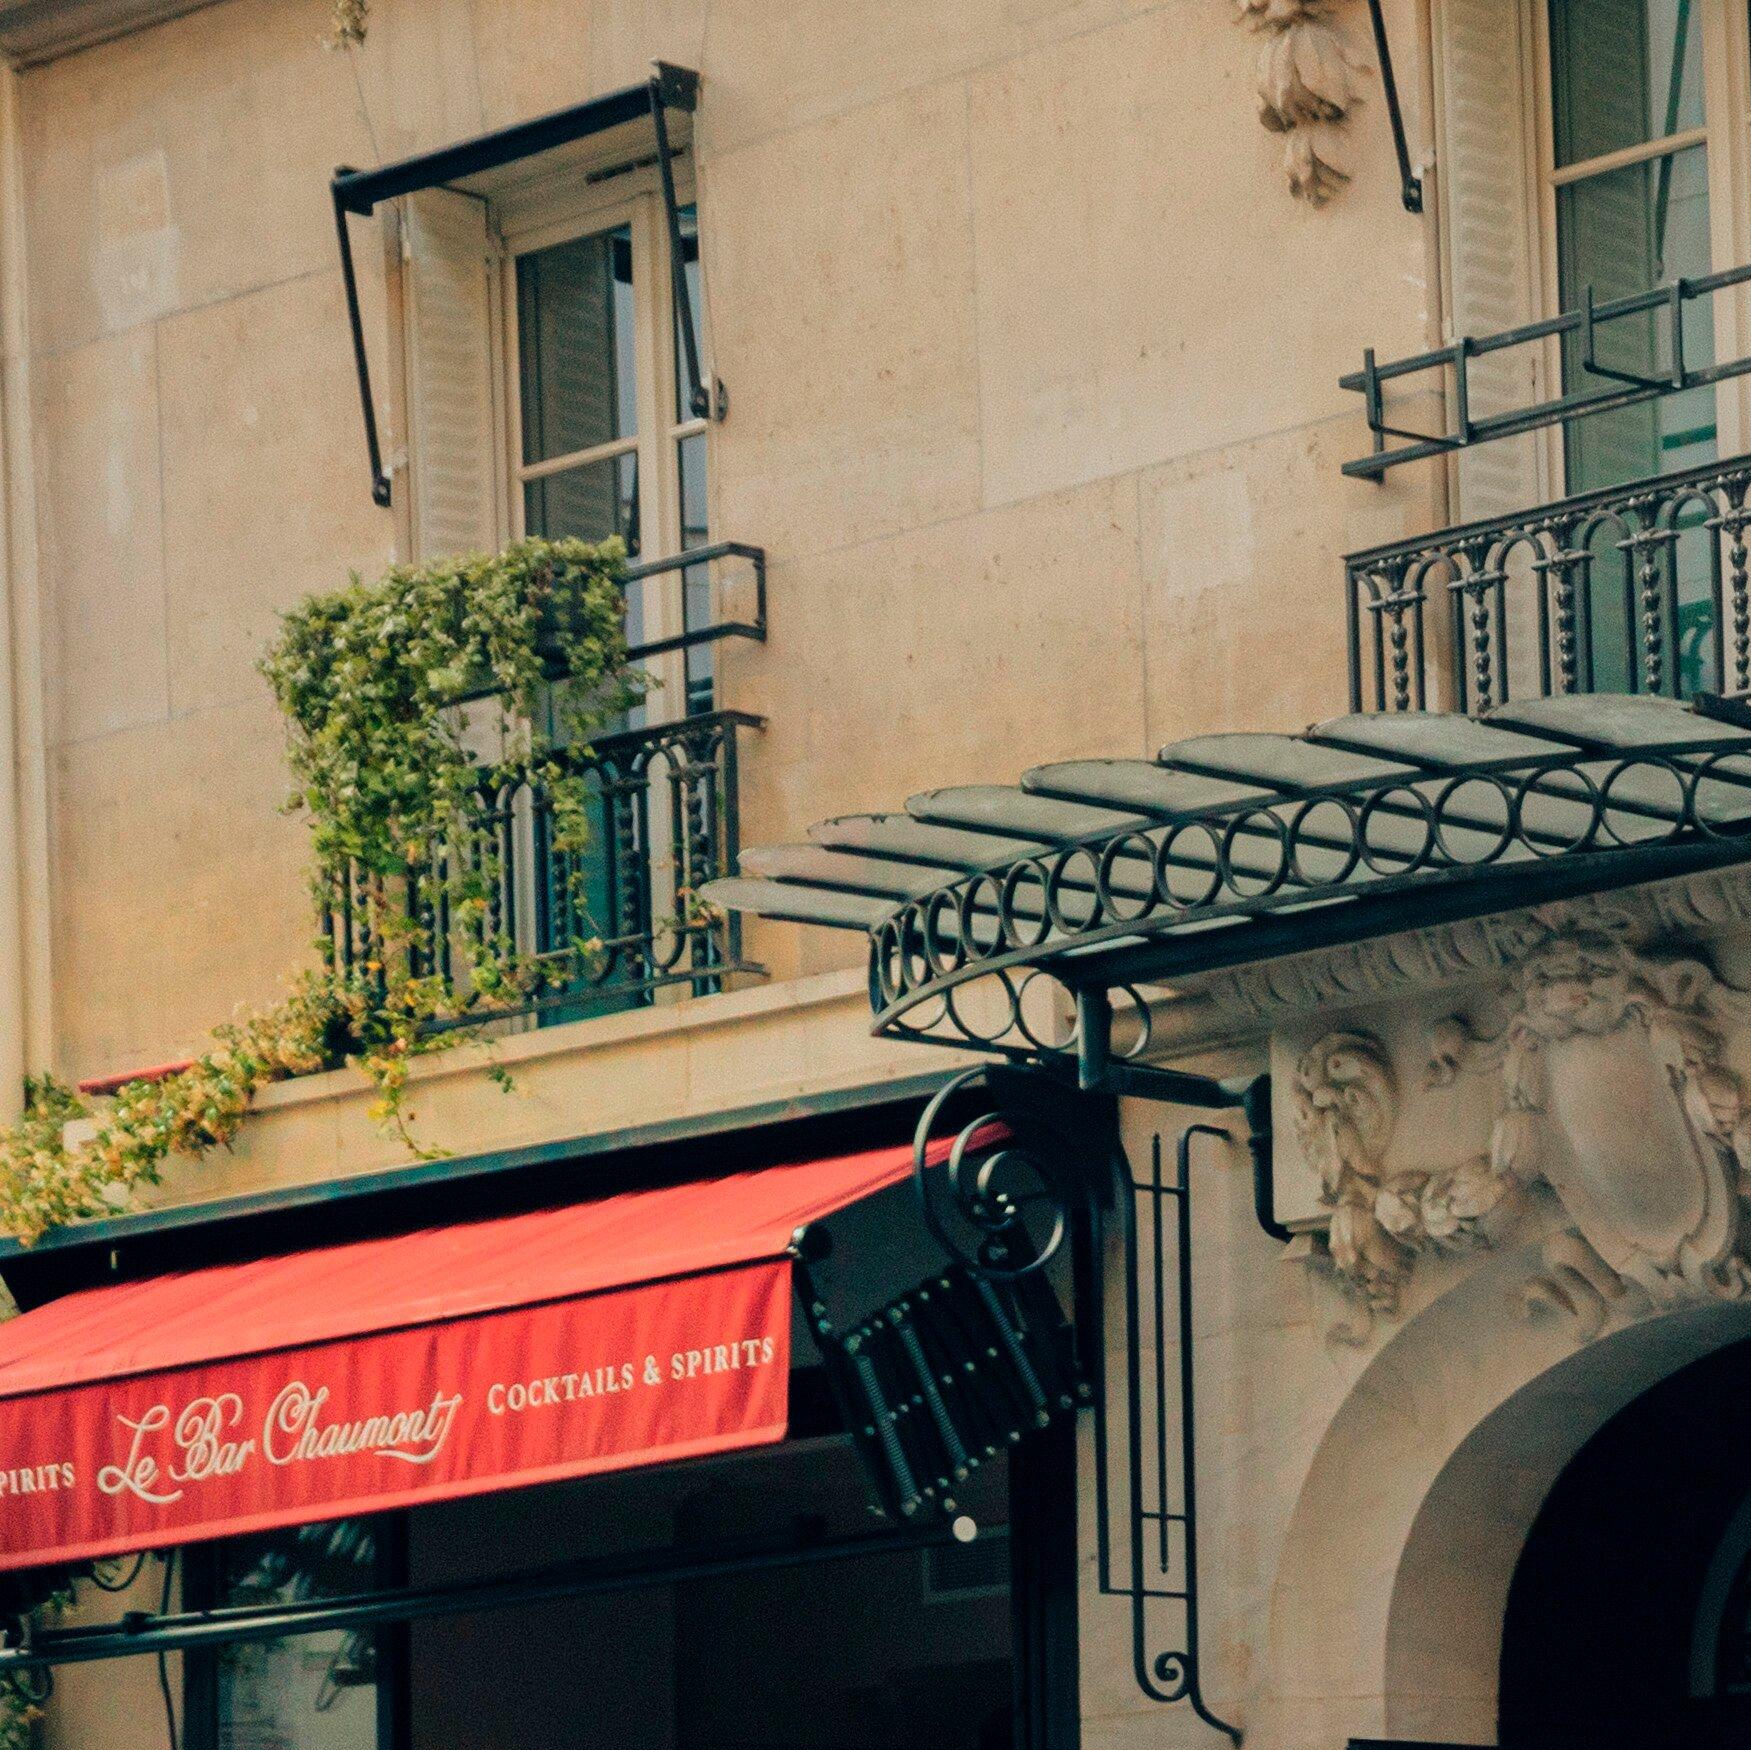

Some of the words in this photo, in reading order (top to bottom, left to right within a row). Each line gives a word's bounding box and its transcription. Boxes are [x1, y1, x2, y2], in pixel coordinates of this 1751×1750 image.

[486, 1362, 634, 1416] COCKTAILS
[642, 1354, 663, 1387] &
[670, 1336, 775, 1380] SPIRITS
[97, 1404, 183, 1503] Le
[168, 1393, 256, 1482] Bar
[262, 1380, 463, 1466] Chaumont
